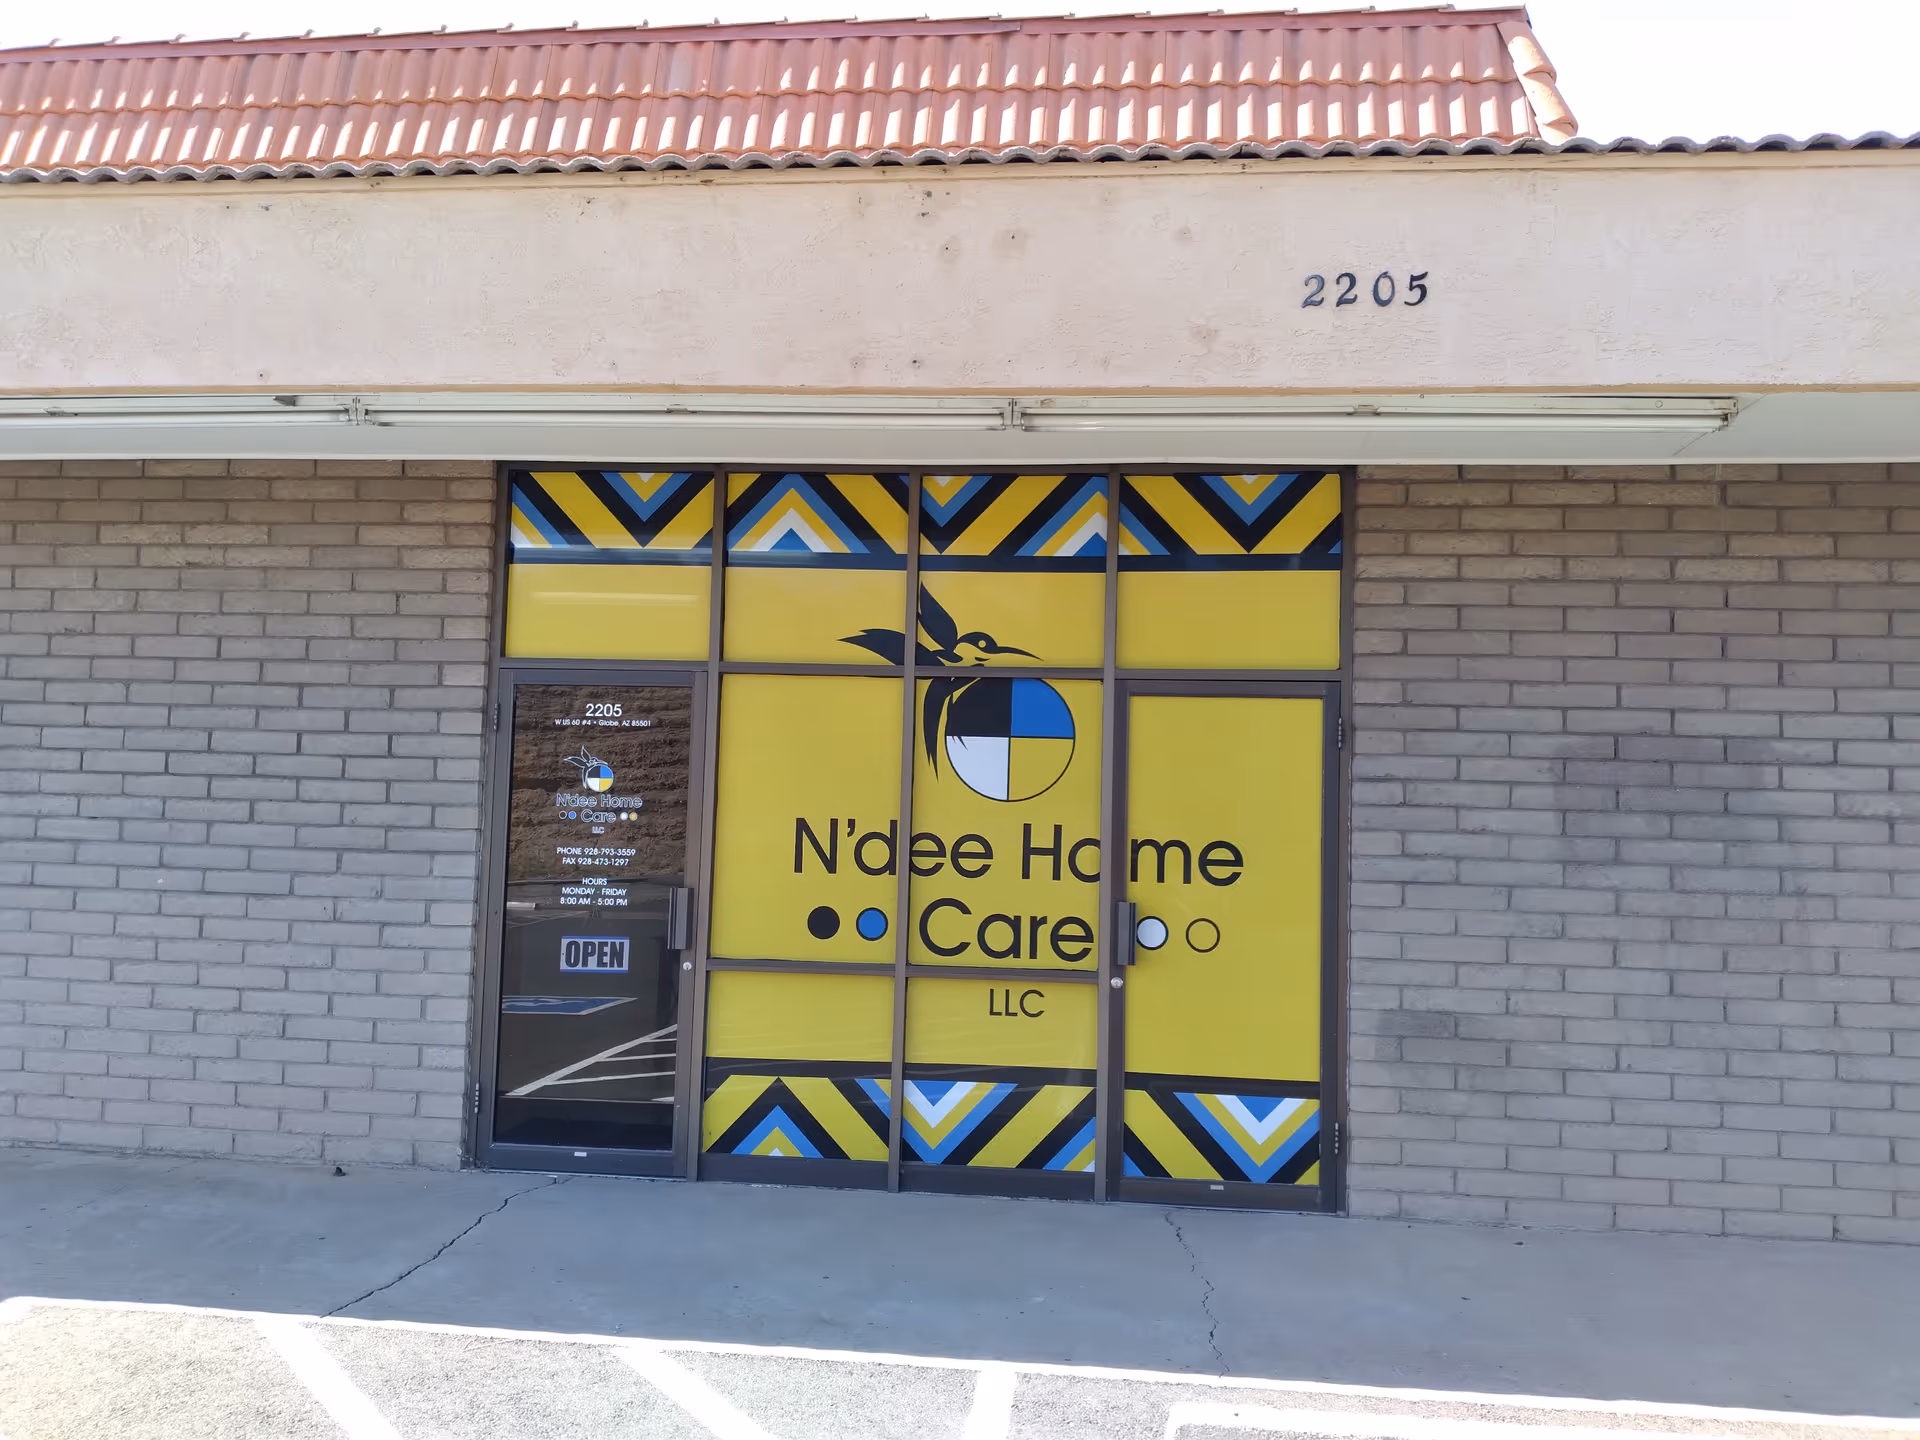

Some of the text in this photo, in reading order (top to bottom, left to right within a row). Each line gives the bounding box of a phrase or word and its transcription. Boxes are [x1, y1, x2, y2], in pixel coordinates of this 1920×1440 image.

[1301, 271, 1429, 308] 2205
[585, 703, 622, 717] 2205
[556, 792, 643, 809] N'dee Home
[580, 808, 617, 823] Care
[591, 825, 605, 834] LLC
[556, 847, 636, 856] PHONE 928-793-3559
[1021, 823, 1244, 886] Home
[562, 857, 629, 866] FAX 928-473-1297
[582, 877, 608, 886] HOURS
[561, 887, 595, 895] MONDAY
[601, 888, 627, 896] FRIDAY
[559, 897, 577, 905] 8:00
[578, 897, 591, 905] AM
[597, 898, 614, 906] 5:00
[615, 898, 628, 906] PM
[918, 897, 1094, 962] Care
[564, 940, 625, 969] OPEN
[989, 988, 1045, 1018] LLC
